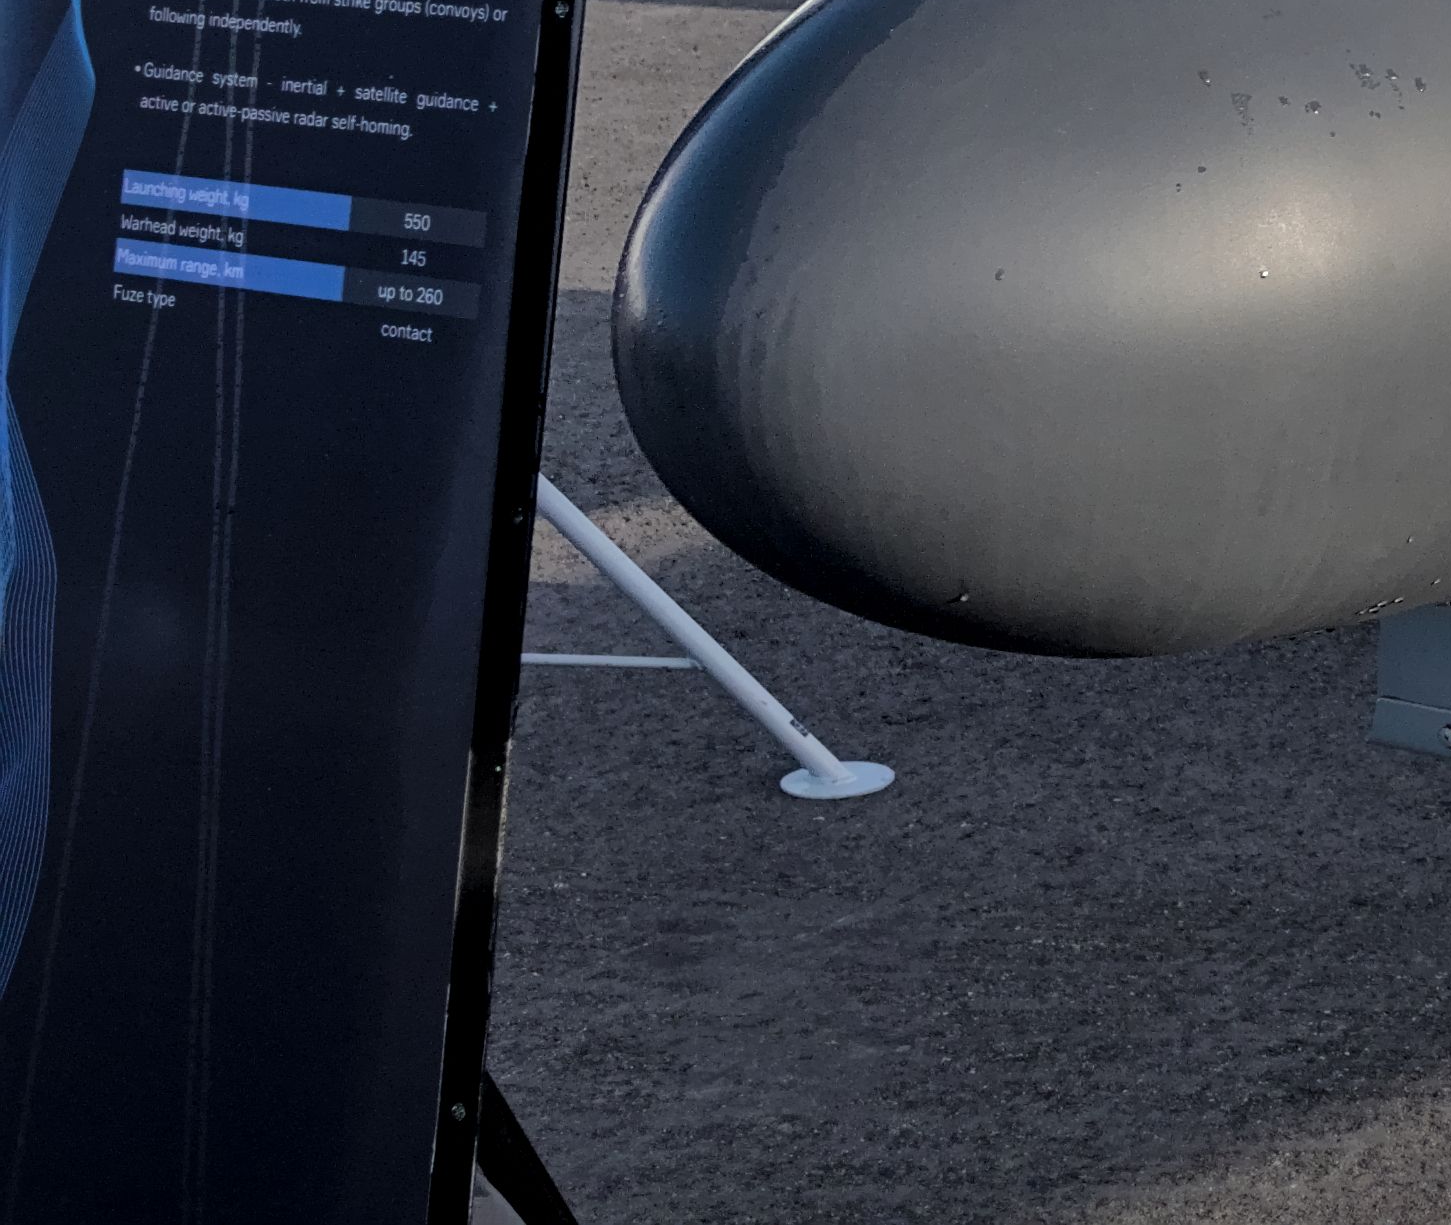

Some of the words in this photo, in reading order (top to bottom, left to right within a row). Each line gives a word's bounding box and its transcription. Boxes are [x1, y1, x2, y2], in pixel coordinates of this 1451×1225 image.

[149, 5, 206, 29] following
[209, 10, 303, 38] independently.
[425, 0, 490, 23] (convoys)
[493, 9, 508, 22] or
[143, 61, 204, 83] Guidance
[212, 72, 258, 88] system
[281, 75, 328, 96] inertial
[355, 86, 408, 105] satellite
[416, 91, 480, 112] guidance
[139, 94, 179, 112] active
[181, 101, 196, 114] or
[198, 101, 290, 124] active-passive
[293, 111, 329, 128] radar
[331, 114, 413, 141] self-homing.
[123, 177, 187, 204] Launching
[233, 190, 250, 212] kg
[120, 213, 176, 236] Warhead
[227, 227, 244, 248] kg
[404, 213, 431, 231] 550
[116, 247, 178, 270] Maximum
[224, 262, 244, 279] km
[400, 249, 427, 267] 145
[113, 284, 144, 303] Fuze
[147, 290, 176, 309] type
[377, 286, 396, 302] up
[399, 286, 413, 301] to
[416, 287, 443, 305] 260
[381, 324, 433, 342] contact
